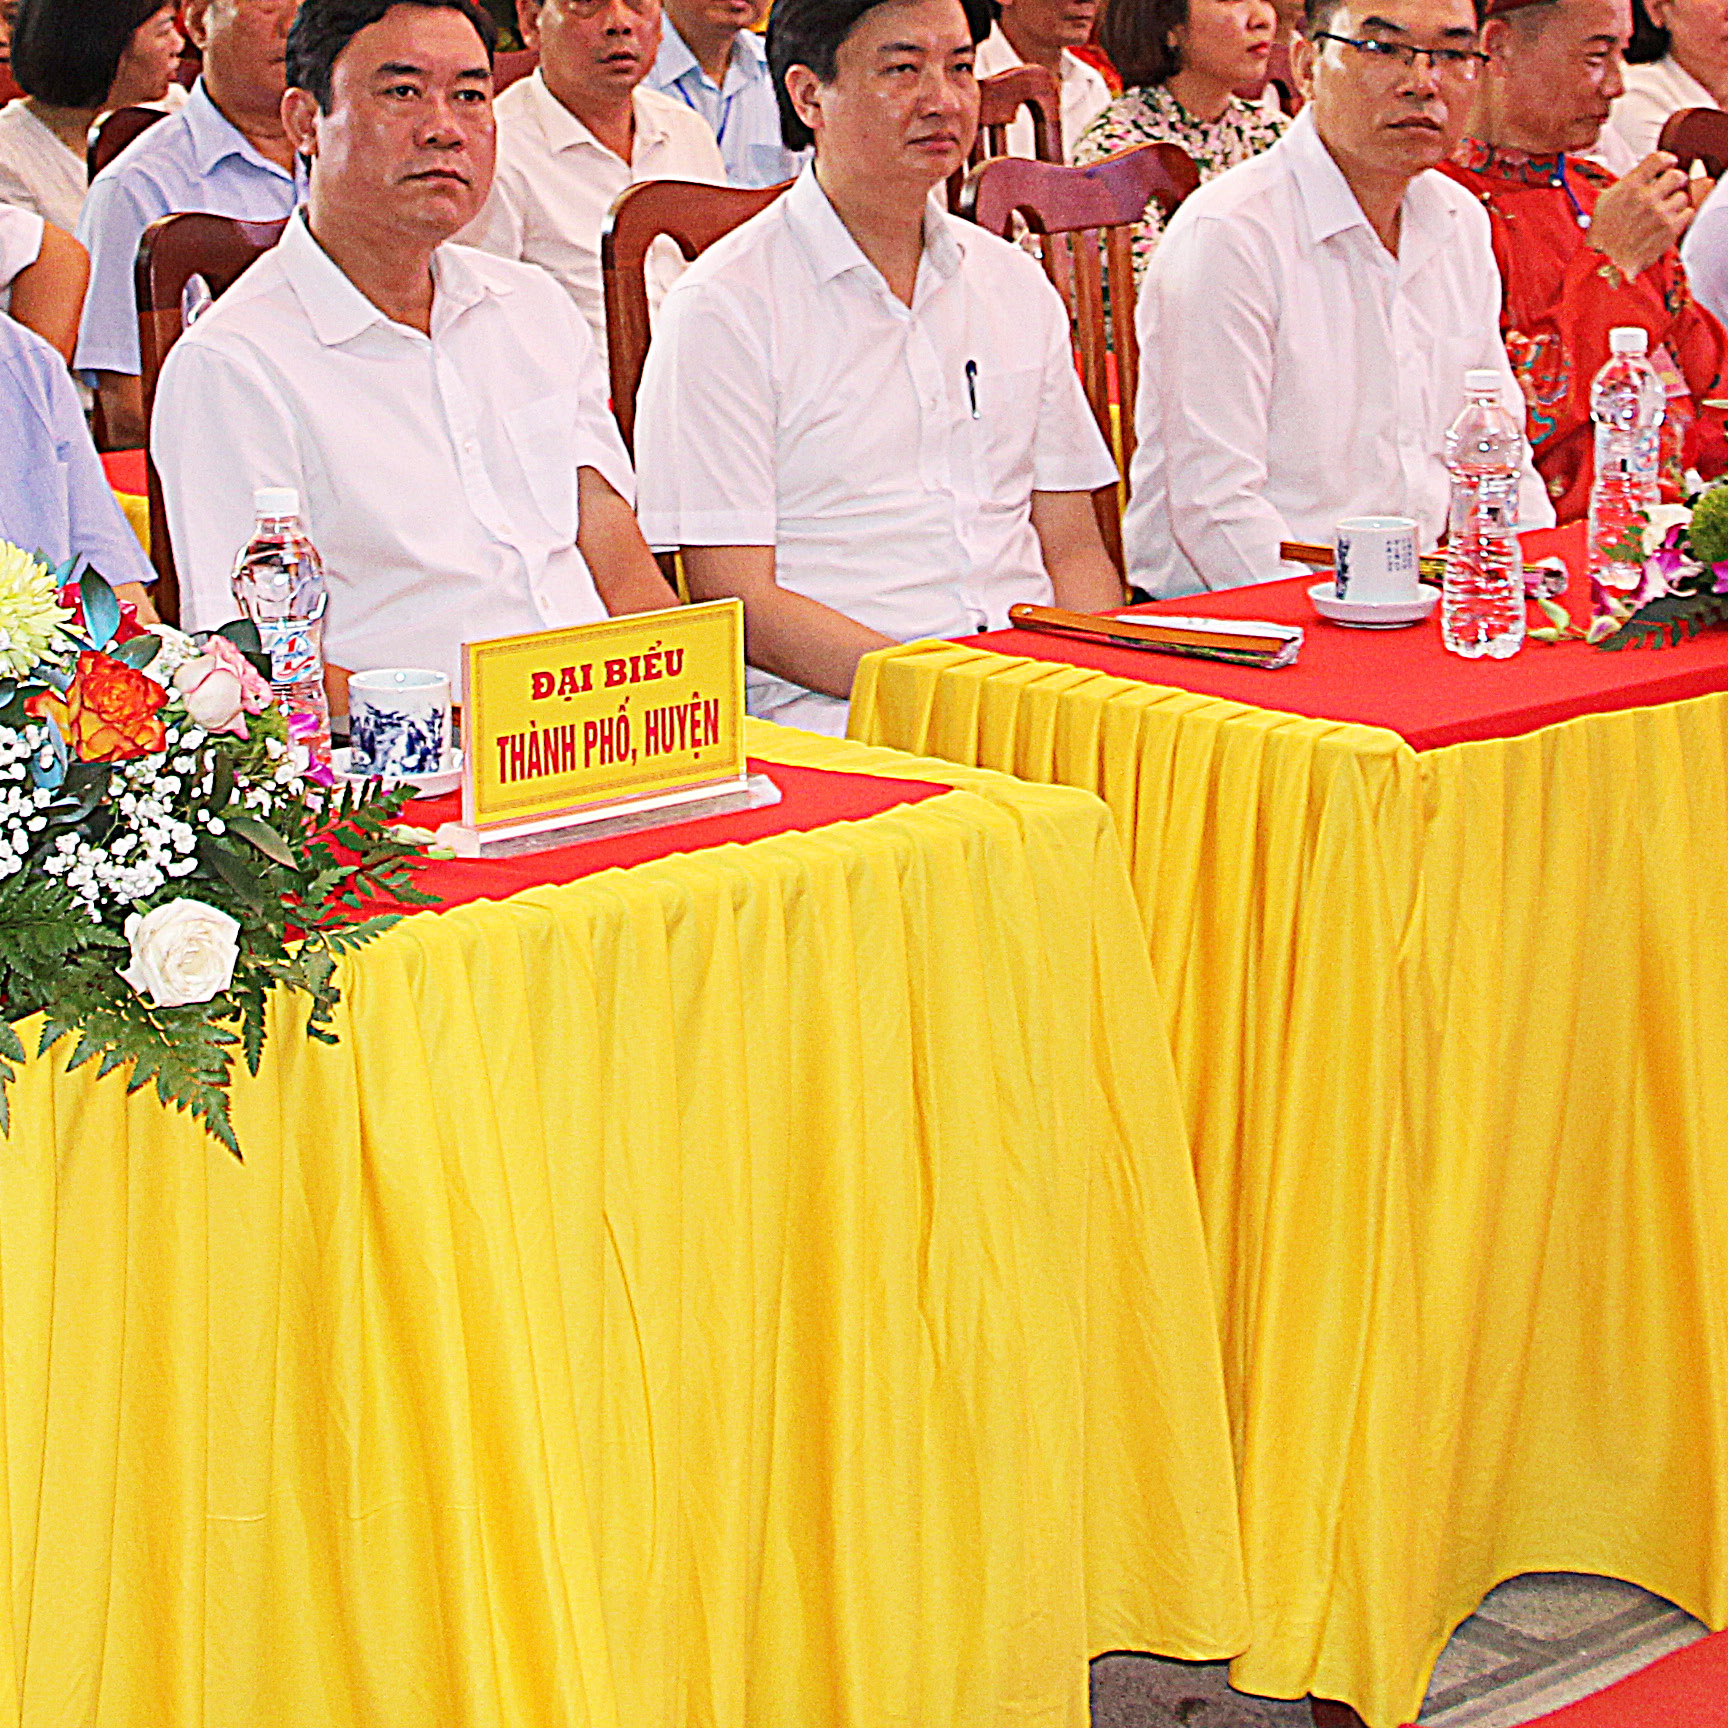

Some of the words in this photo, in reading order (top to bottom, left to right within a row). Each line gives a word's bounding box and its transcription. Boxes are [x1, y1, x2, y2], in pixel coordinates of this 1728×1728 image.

[531, 663, 593, 702] ĐẠI
[604, 640, 685, 689] BIỂU
[496, 719, 576, 784] THÀNH
[584, 696, 637, 769] PHỐ,
[645, 691, 719, 760] HUYỆN
